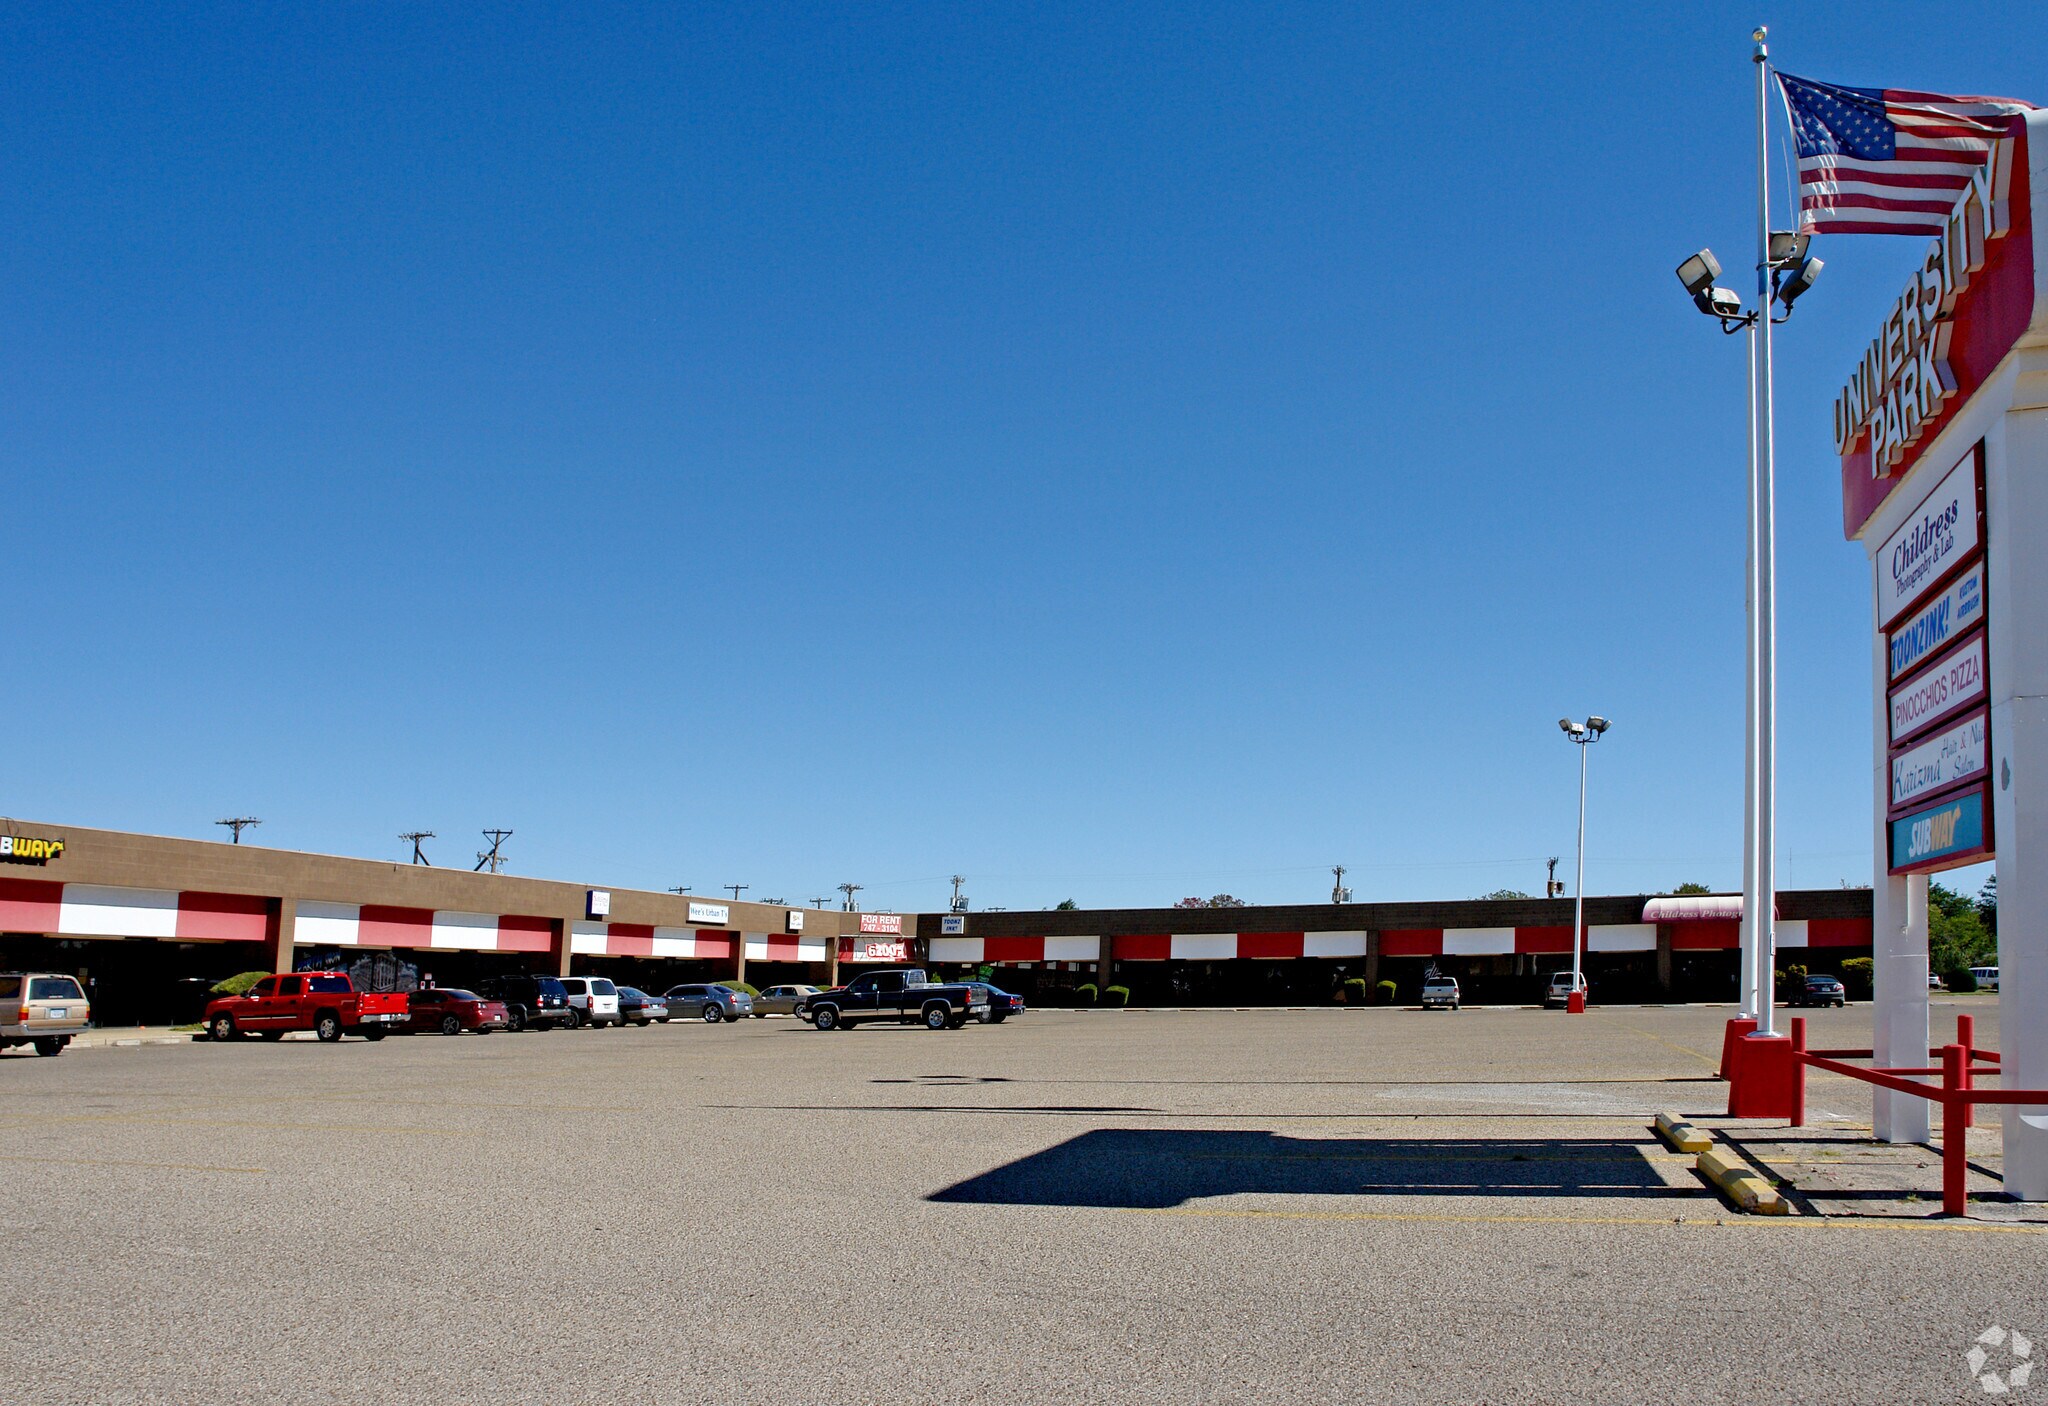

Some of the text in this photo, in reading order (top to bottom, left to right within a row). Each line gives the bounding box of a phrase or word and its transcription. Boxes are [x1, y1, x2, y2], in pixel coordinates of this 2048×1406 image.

[1834, 137, 2013, 455] UNIVERSITY
[1871, 320, 1957, 480] PARK
[1892, 499, 1958, 580] Childress
[1896, 529, 1955, 598] Photography & Lab
[1891, 595, 1951, 674] TOONZINK!
[1895, 654, 1980, 729] PINOCCHIOS PIZZA
[1952, 753, 1975, 779] Salon
[1960, 731, 1967, 750] &
[1893, 759, 1941, 800] Karizma
[0, 836, 64, 859] BWAY
[1908, 803, 1962, 859] SUBWAY
[861, 914, 902, 925] FOR RENT
[1650, 909, 1743, 920] Childress Photogr
